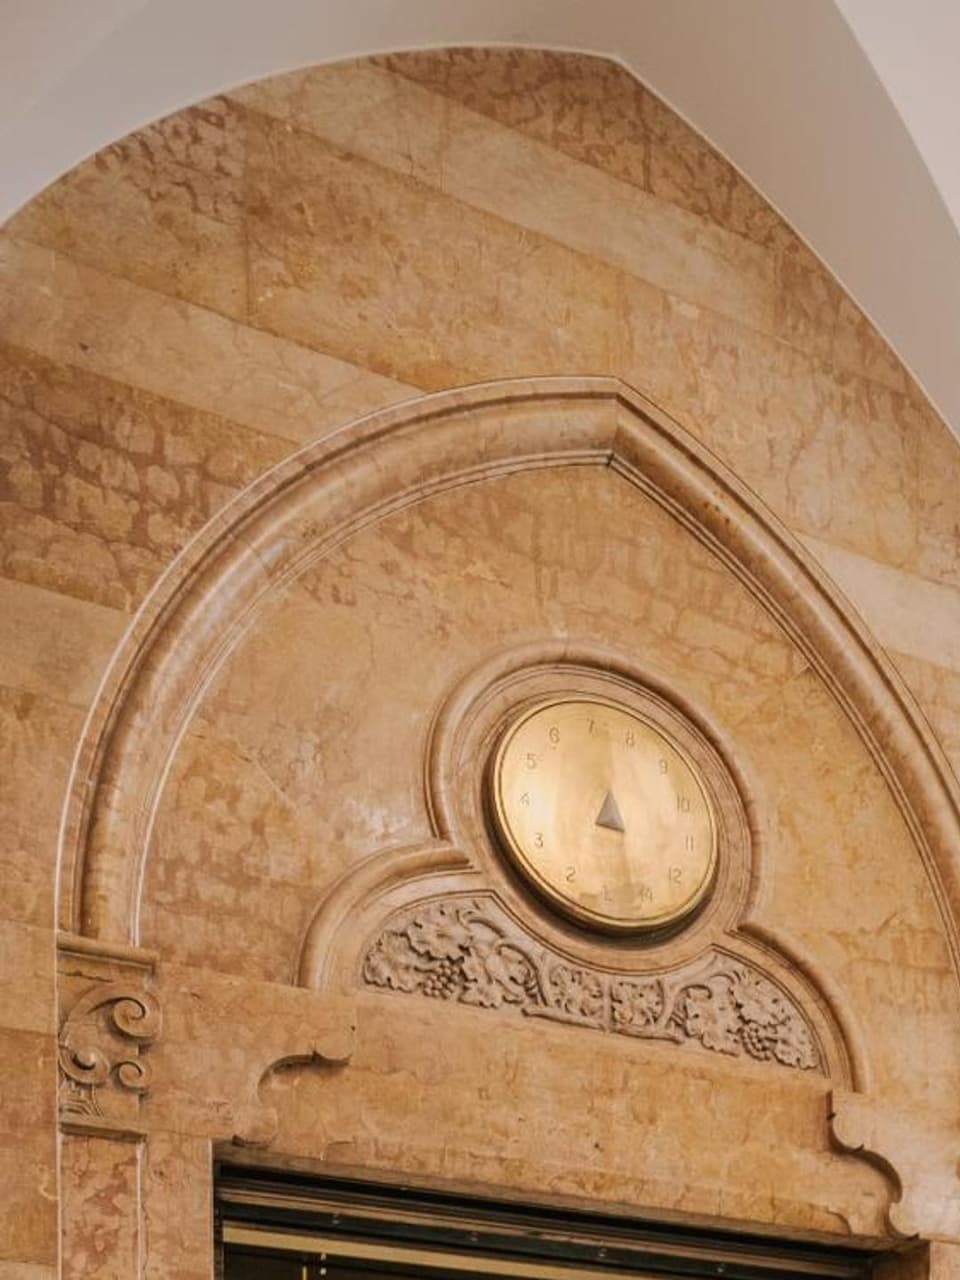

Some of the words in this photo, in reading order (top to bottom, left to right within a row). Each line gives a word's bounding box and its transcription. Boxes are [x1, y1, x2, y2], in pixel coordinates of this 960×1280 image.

[549, 726, 560, 743] 6
[625, 730, 635, 747] 8
[525, 752, 537, 770] 5
[658, 758, 668, 775] 9
[676, 796, 690, 812] 10
[533, 832, 544, 848] 3
[685, 835, 695, 851] 11
[565, 866, 576, 882] 2
[667, 867, 682, 884] 12
